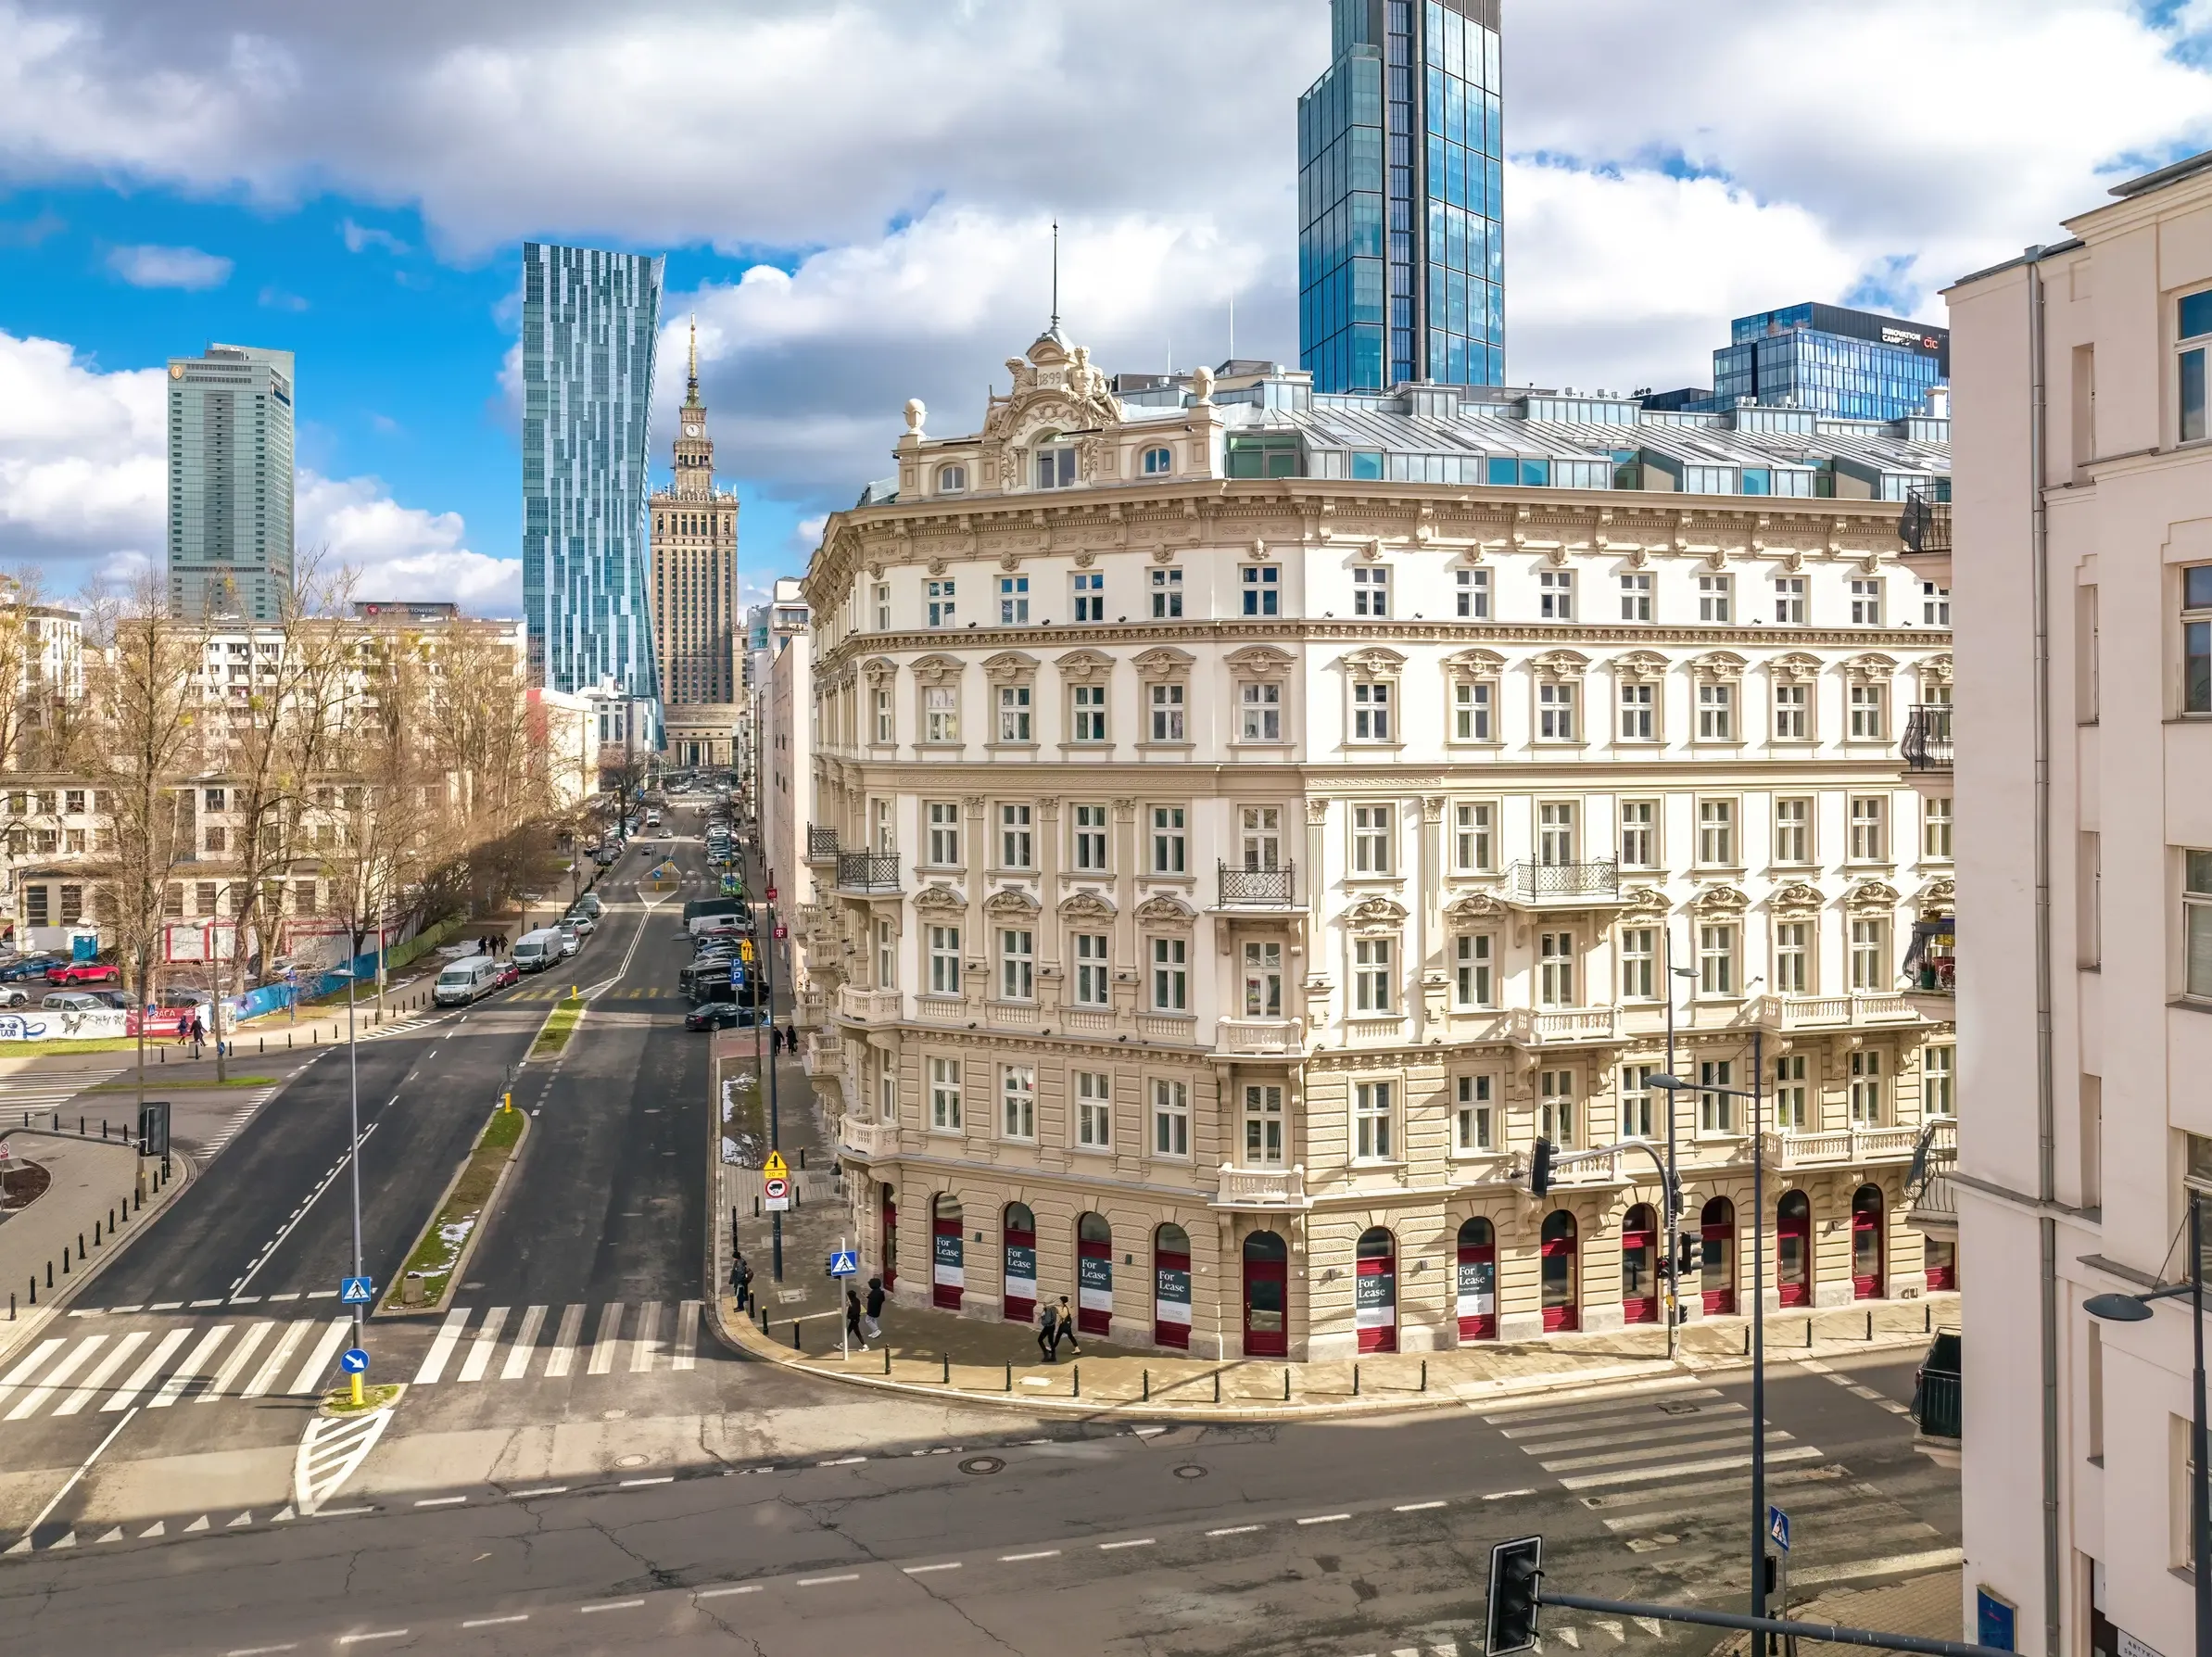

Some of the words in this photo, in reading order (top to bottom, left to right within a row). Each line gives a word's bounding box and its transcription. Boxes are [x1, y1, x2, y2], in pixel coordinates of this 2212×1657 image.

[1038, 372, 1061, 386] 1899
[776, 929, 784, 938] T
[733, 958, 740, 968] P
[733, 971, 741, 980] P
[146, 1009, 176, 1020] RACA
[936, 1236, 950, 1247] For
[936, 1246, 959, 1258] Lease
[1006, 1247, 1022, 1259] For
[1007, 1257, 1031, 1269] Lease
[1081, 1259, 1097, 1270] For
[1081, 1268, 1106, 1281] Lease
[1158, 1270, 1174, 1281] For
[1459, 1267, 1475, 1276] For
[1359, 1279, 1375, 1288] For
[1459, 1276, 1485, 1285] Lease
[1158, 1280, 1185, 1293] Lease
[1359, 1288, 1385, 1298] Lease
